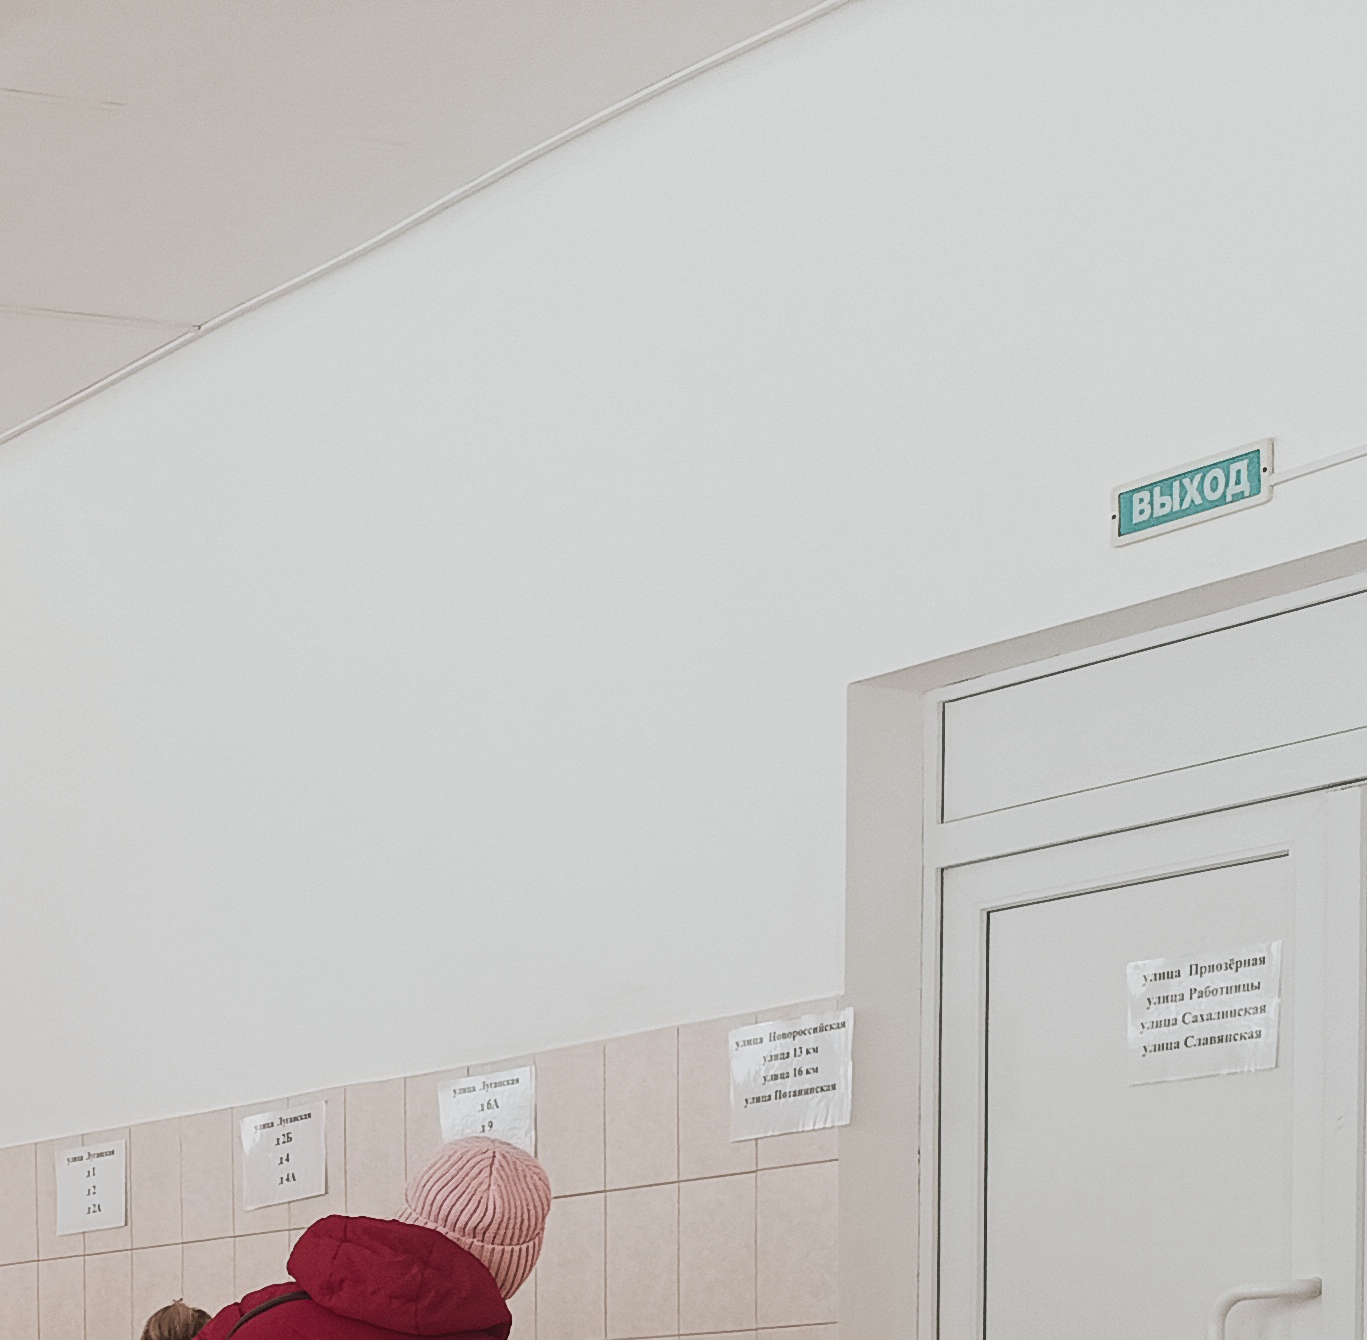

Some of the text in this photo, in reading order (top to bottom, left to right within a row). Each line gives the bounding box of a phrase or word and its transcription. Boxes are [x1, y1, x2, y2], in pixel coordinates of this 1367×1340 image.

[1132, 459, 1250, 524] ВЫХОД
[1142, 955, 1266, 987] улица Приозёрная
[1146, 980, 1261, 1010] улица Работницы
[1139, 1003, 1267, 1035] улица Сахалинская
[735, 1020, 846, 1051] улица Новороссийская
[1141, 1029, 1262, 1057] улица Славянская
[762, 1046, 819, 1066] улица 13 км
[762, 1066, 819, 1086] улица 16 км
[744, 1093, 772, 1108] улица
